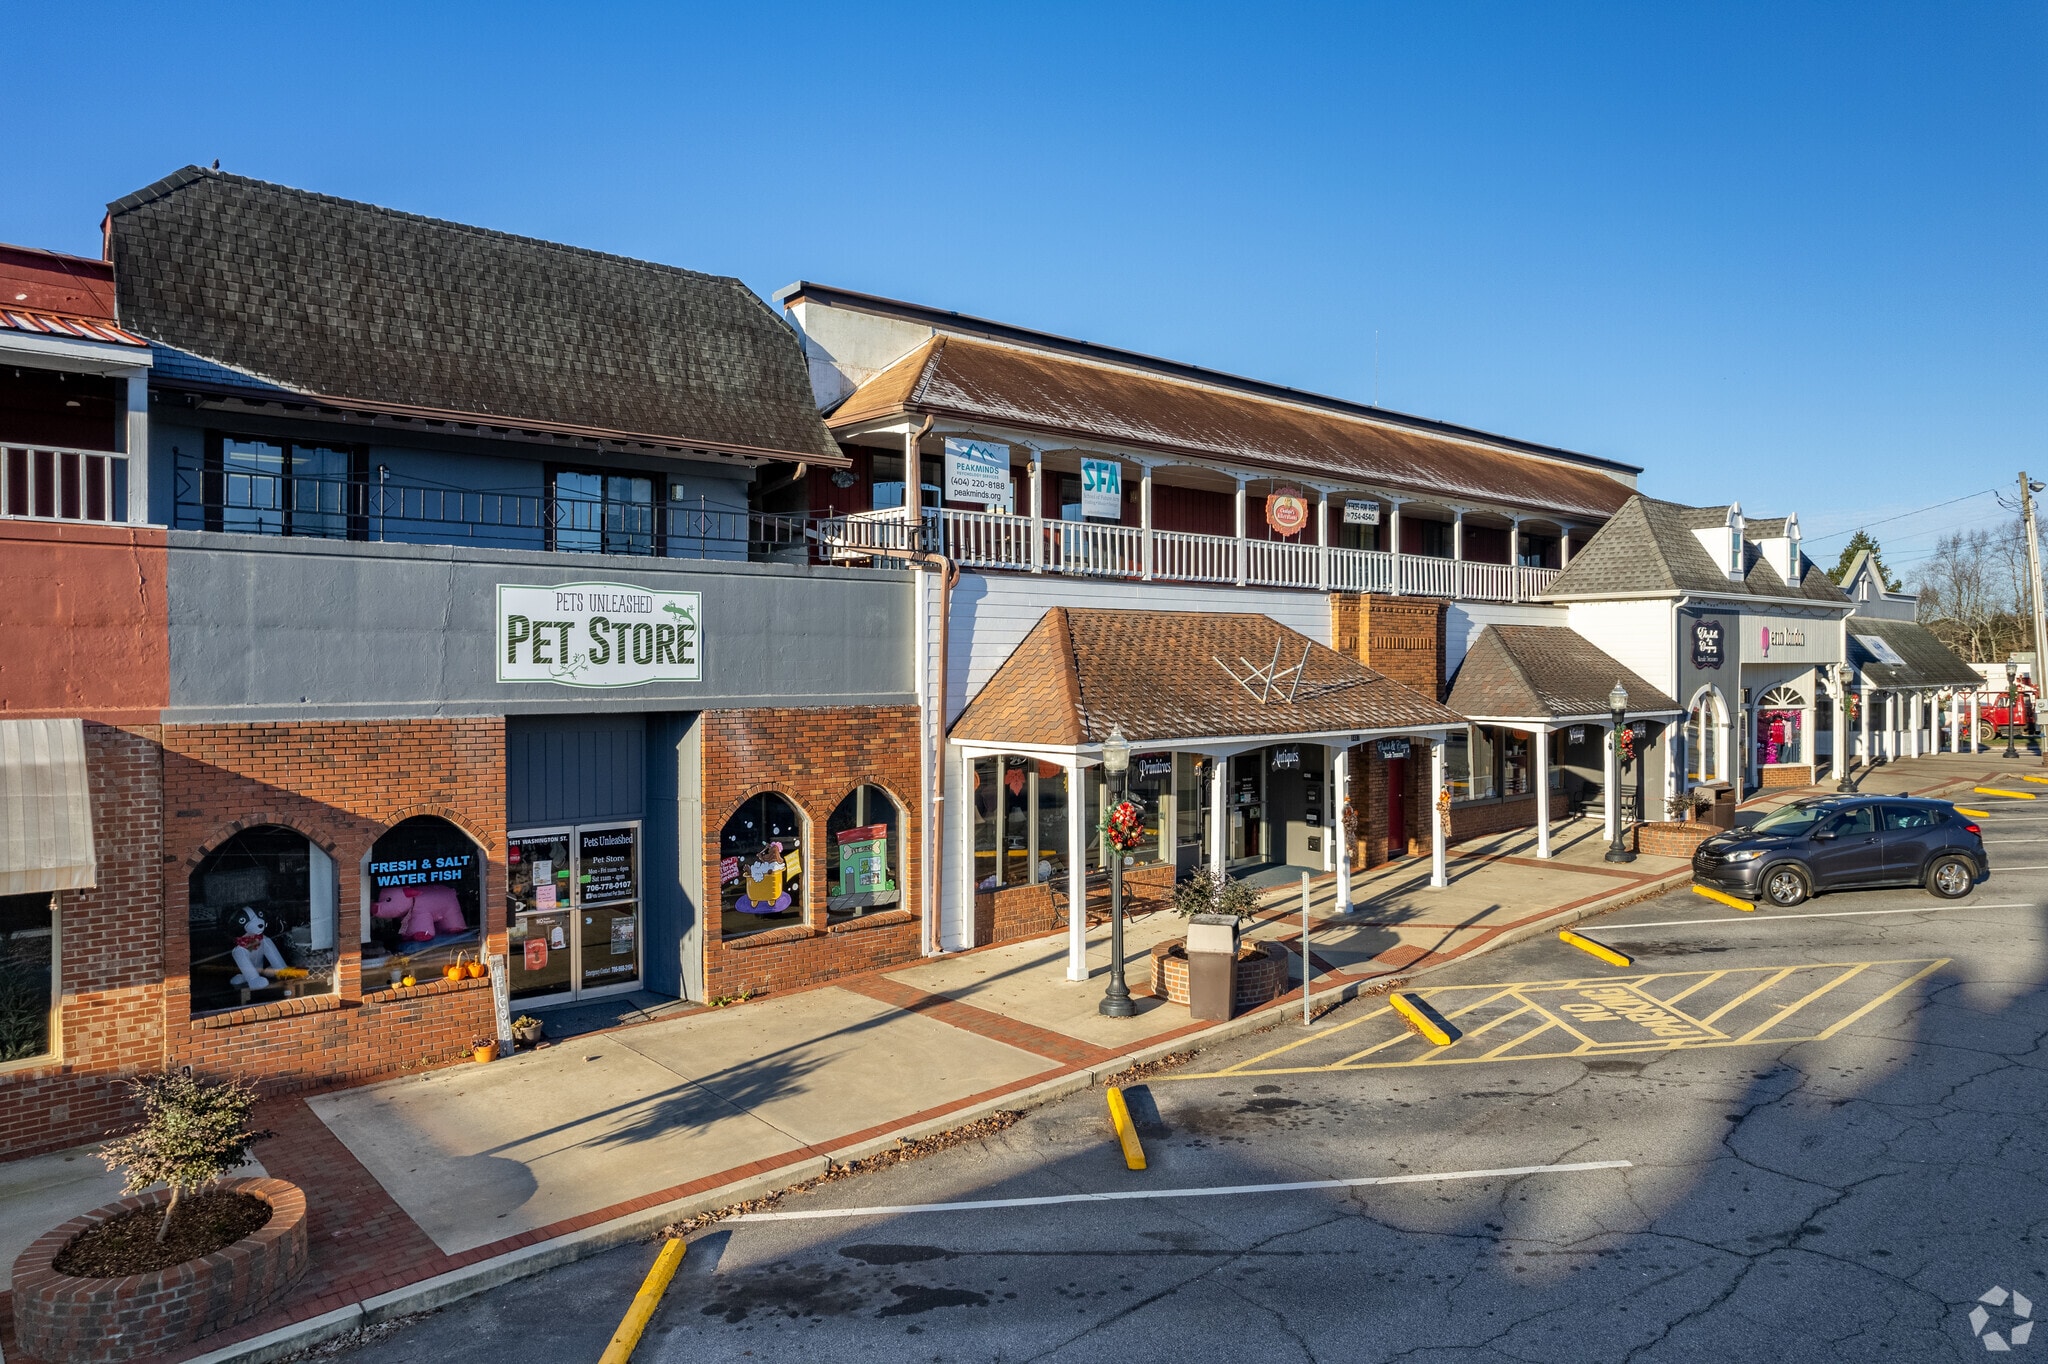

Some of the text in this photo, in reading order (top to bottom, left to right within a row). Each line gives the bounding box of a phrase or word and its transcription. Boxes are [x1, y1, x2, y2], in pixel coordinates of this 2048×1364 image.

[956, 462, 999, 475] PEAKMINDS
[1083, 461, 1120, 494] SFA
[950, 476, 970, 487] (404)
[954, 489, 1001, 501] peakminds.org
[1360, 503, 1368, 511] FOR
[1368, 504, 1379, 512] RENT
[556, 592, 653, 614] PETS UNLEASHED
[508, 614, 695, 665] PET STORE
[1770, 631, 1784, 646] erin
[1272, 749, 1299, 767] Antiques
[1139, 758, 1171, 782] Primitives
[522, 837, 558, 845] WASHINGTON
[583, 833, 633, 847] Pets Unleashed
[370, 855, 470, 873] FRESH & SALT
[606, 855, 625, 863] Store
[377, 869, 462, 887] WATER FISH
[586, 881, 631, 892] 706-778-0107
[495, 965, 511, 1041] WELCOME
[1560, 1003, 1621, 1022] NO
[1578, 988, 1703, 1037] PARKING
